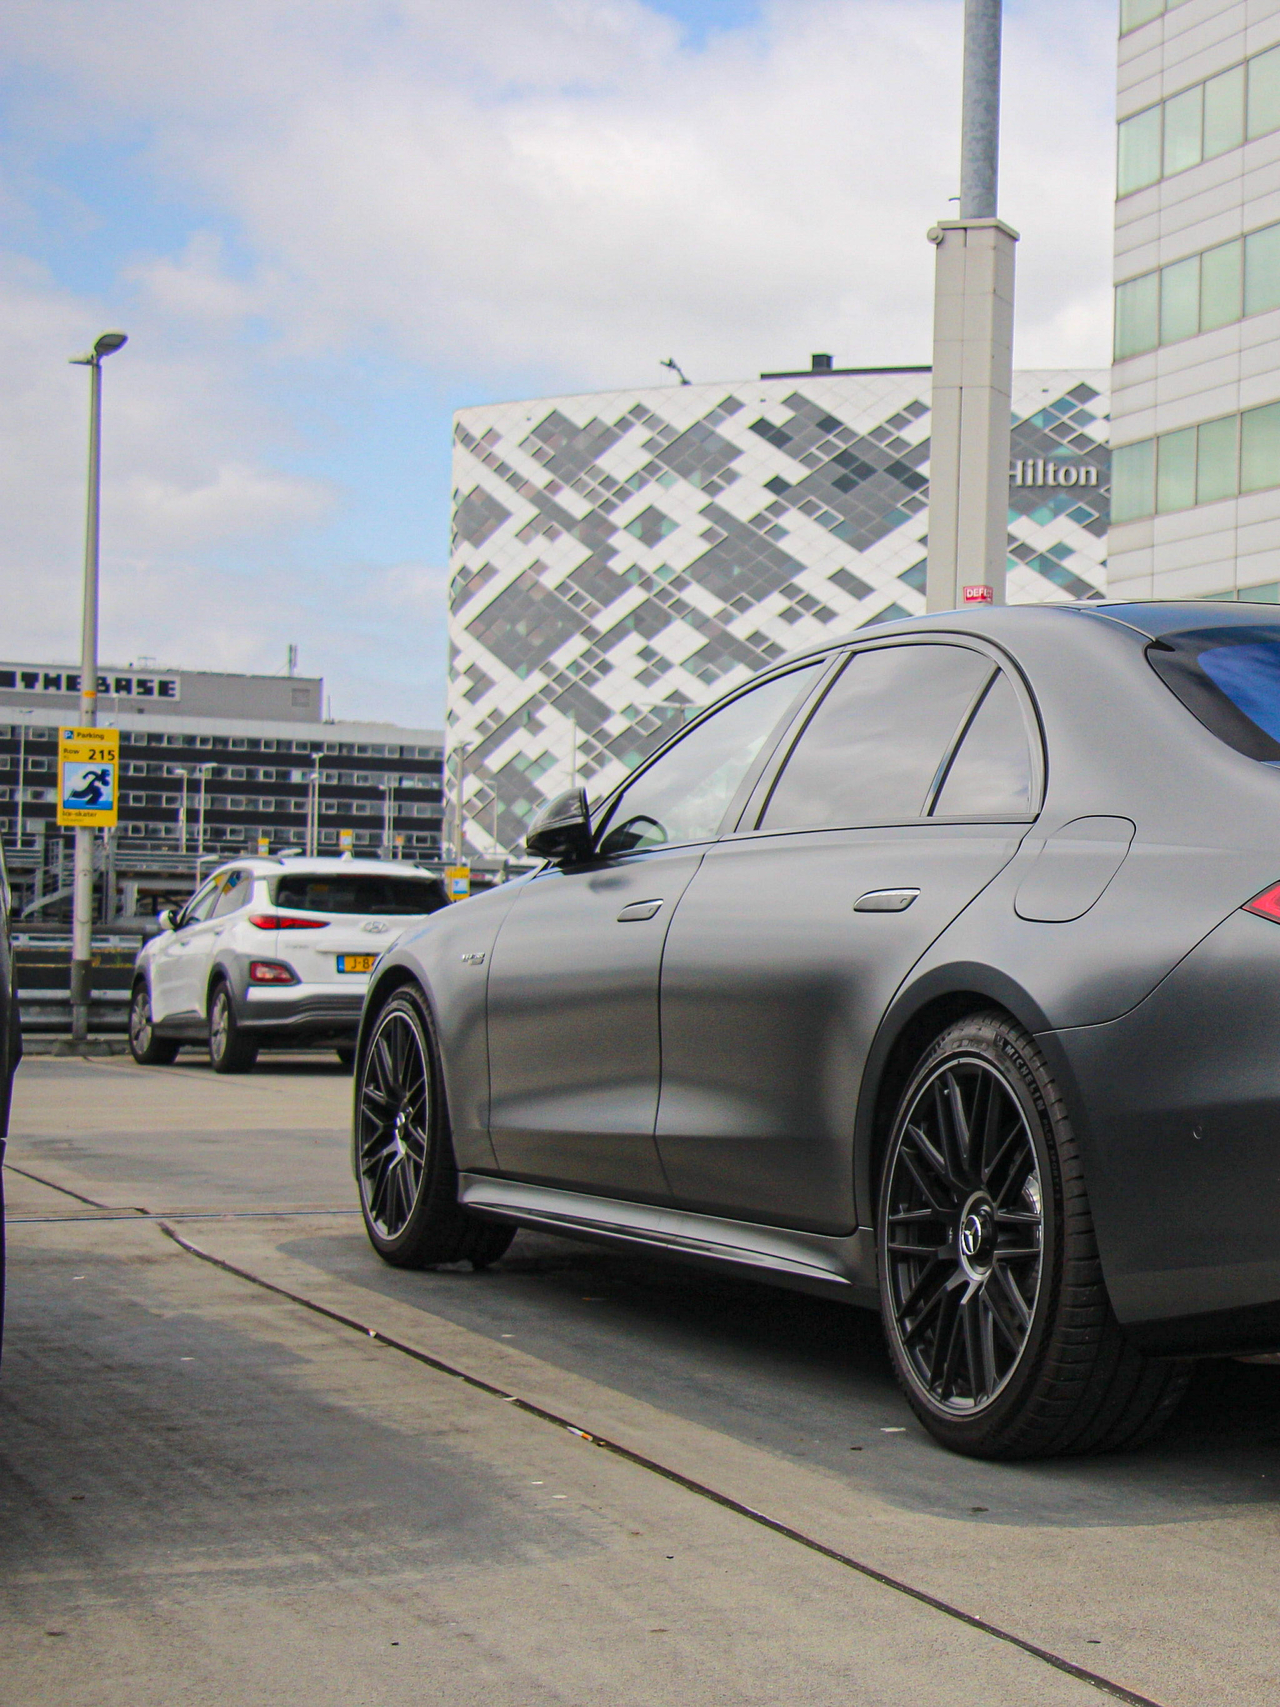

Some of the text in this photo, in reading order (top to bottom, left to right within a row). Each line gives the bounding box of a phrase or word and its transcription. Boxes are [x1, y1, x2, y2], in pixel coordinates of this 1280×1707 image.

[1008, 458, 1098, 487] Hilton
[21, 671, 176, 697] THE BASE
[77, 732, 104, 740] Parking
[88, 749, 115, 761] 215
[1004, 1044, 1045, 1111] MICHELIN
[1042, 1118, 1053, 1146] PILOT
